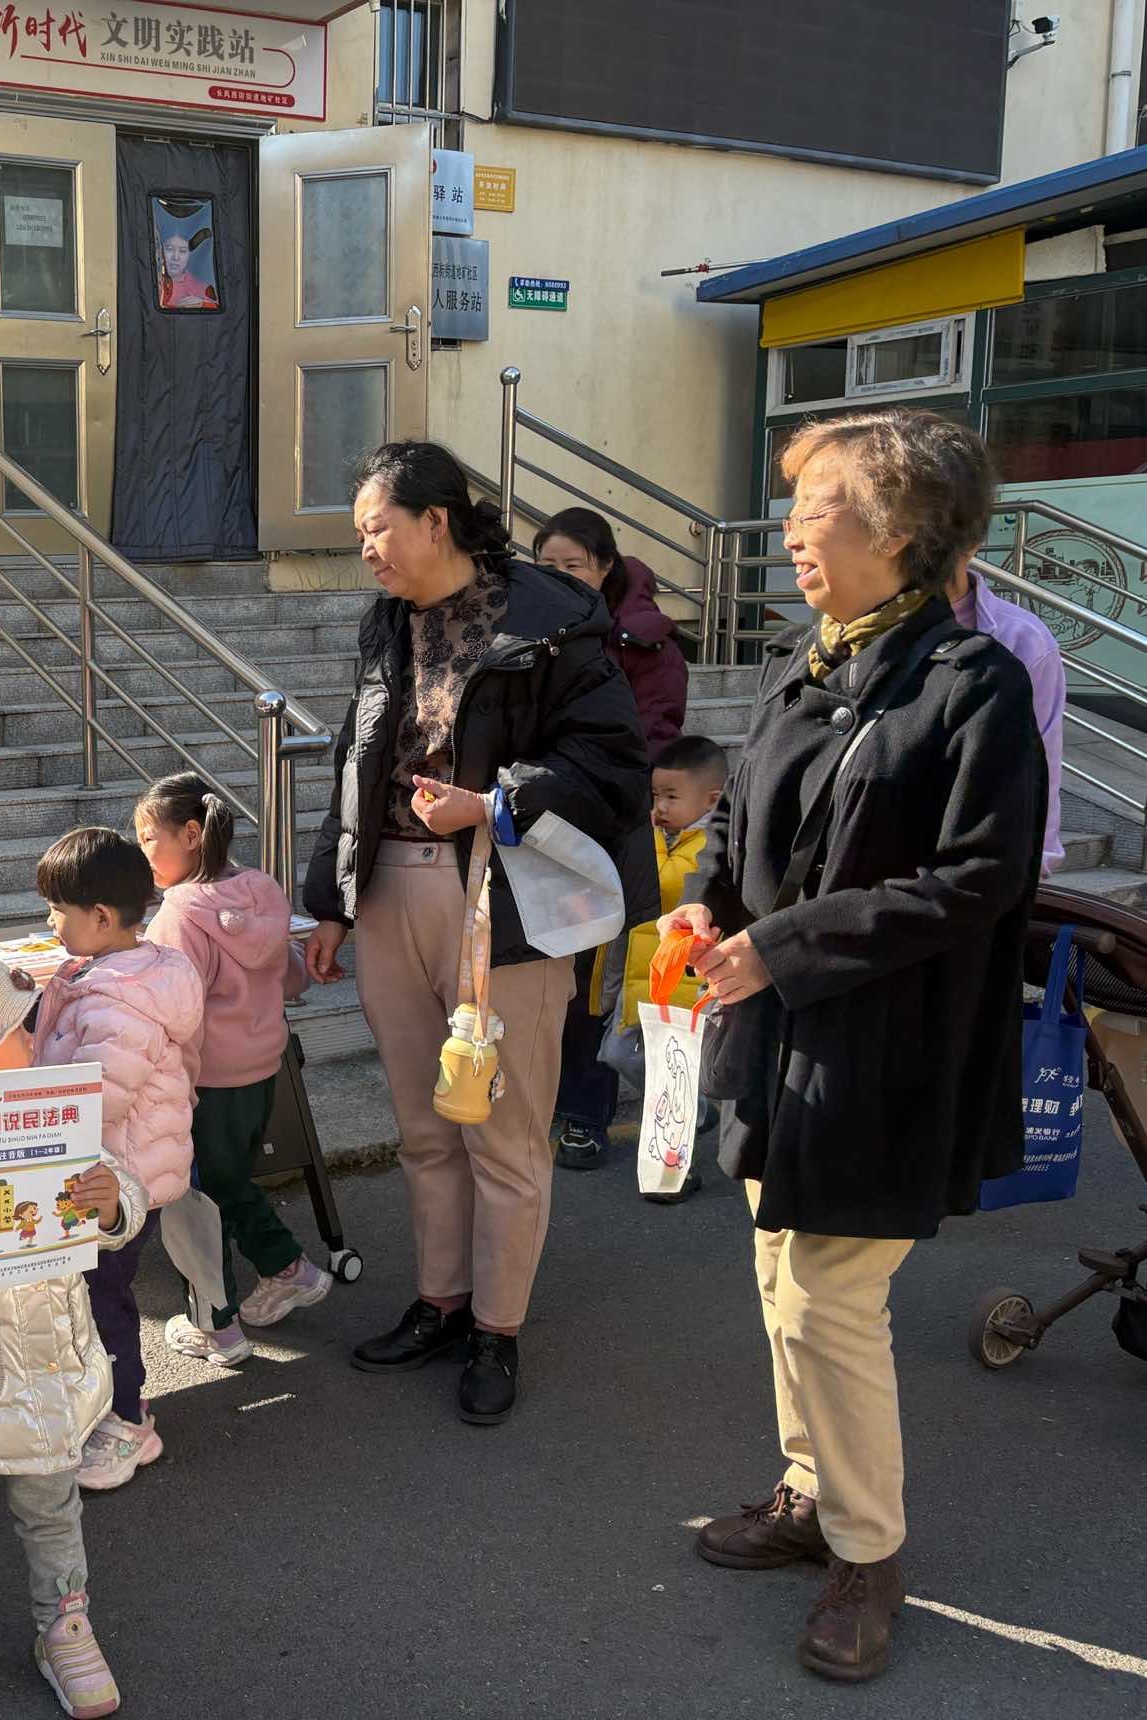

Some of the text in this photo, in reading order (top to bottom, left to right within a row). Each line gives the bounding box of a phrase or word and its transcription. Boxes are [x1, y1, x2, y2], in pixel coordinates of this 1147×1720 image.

[100, 11, 256, 64] 文明实践站
[100, 52, 256, 79] XIN SHI DAI WEN MING SHI JIAN ZHAN
